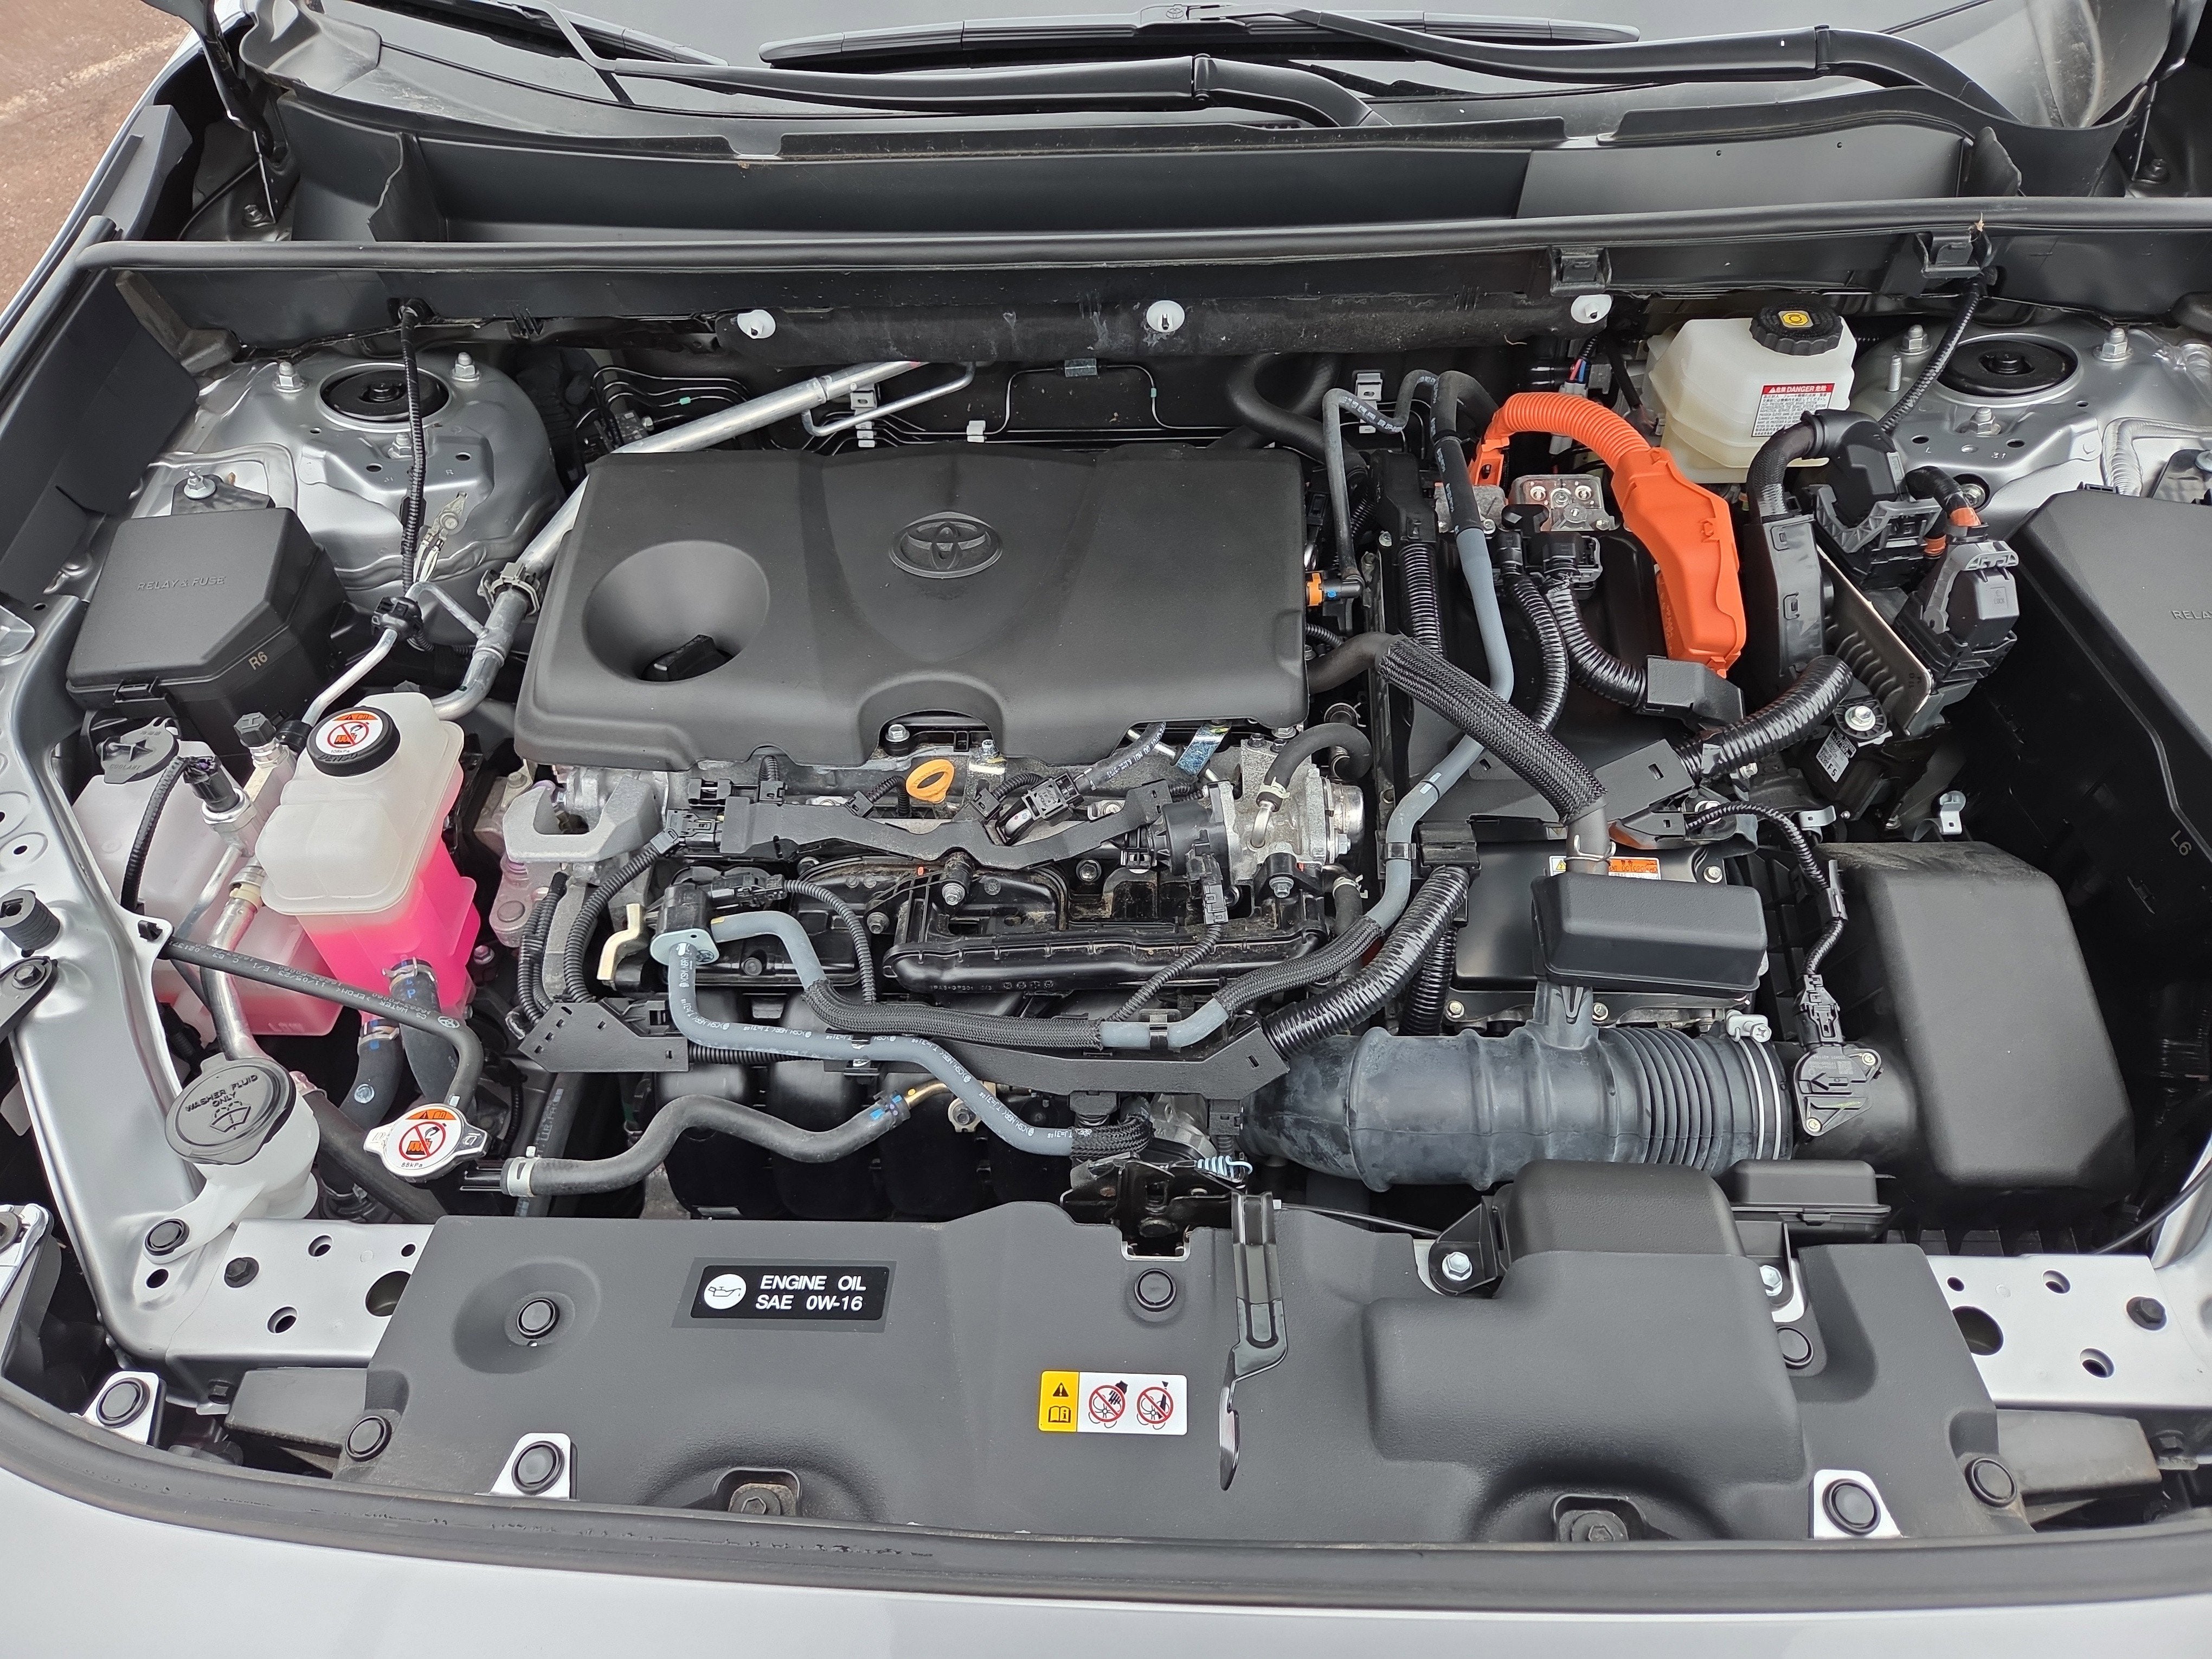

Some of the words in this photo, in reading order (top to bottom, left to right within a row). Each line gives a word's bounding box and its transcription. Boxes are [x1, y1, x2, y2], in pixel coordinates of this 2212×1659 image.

[137, 578, 179, 590] RELAY
[192, 576, 226, 587] FUSE
[248, 651, 268, 670] R6
[2170, 829, 2192, 856] L6
[379, 1000, 408, 1014] WATER
[185, 1089, 227, 1113] WASHER
[230, 1075, 259, 1091] FLUID
[212, 1091, 236, 1107] ONLY
[760, 1275, 827, 1290] ENGINE
[838, 1275, 867, 1291] OIL
[755, 1294, 794, 1310] SAE
[806, 1295, 864, 1311] 0W-16
